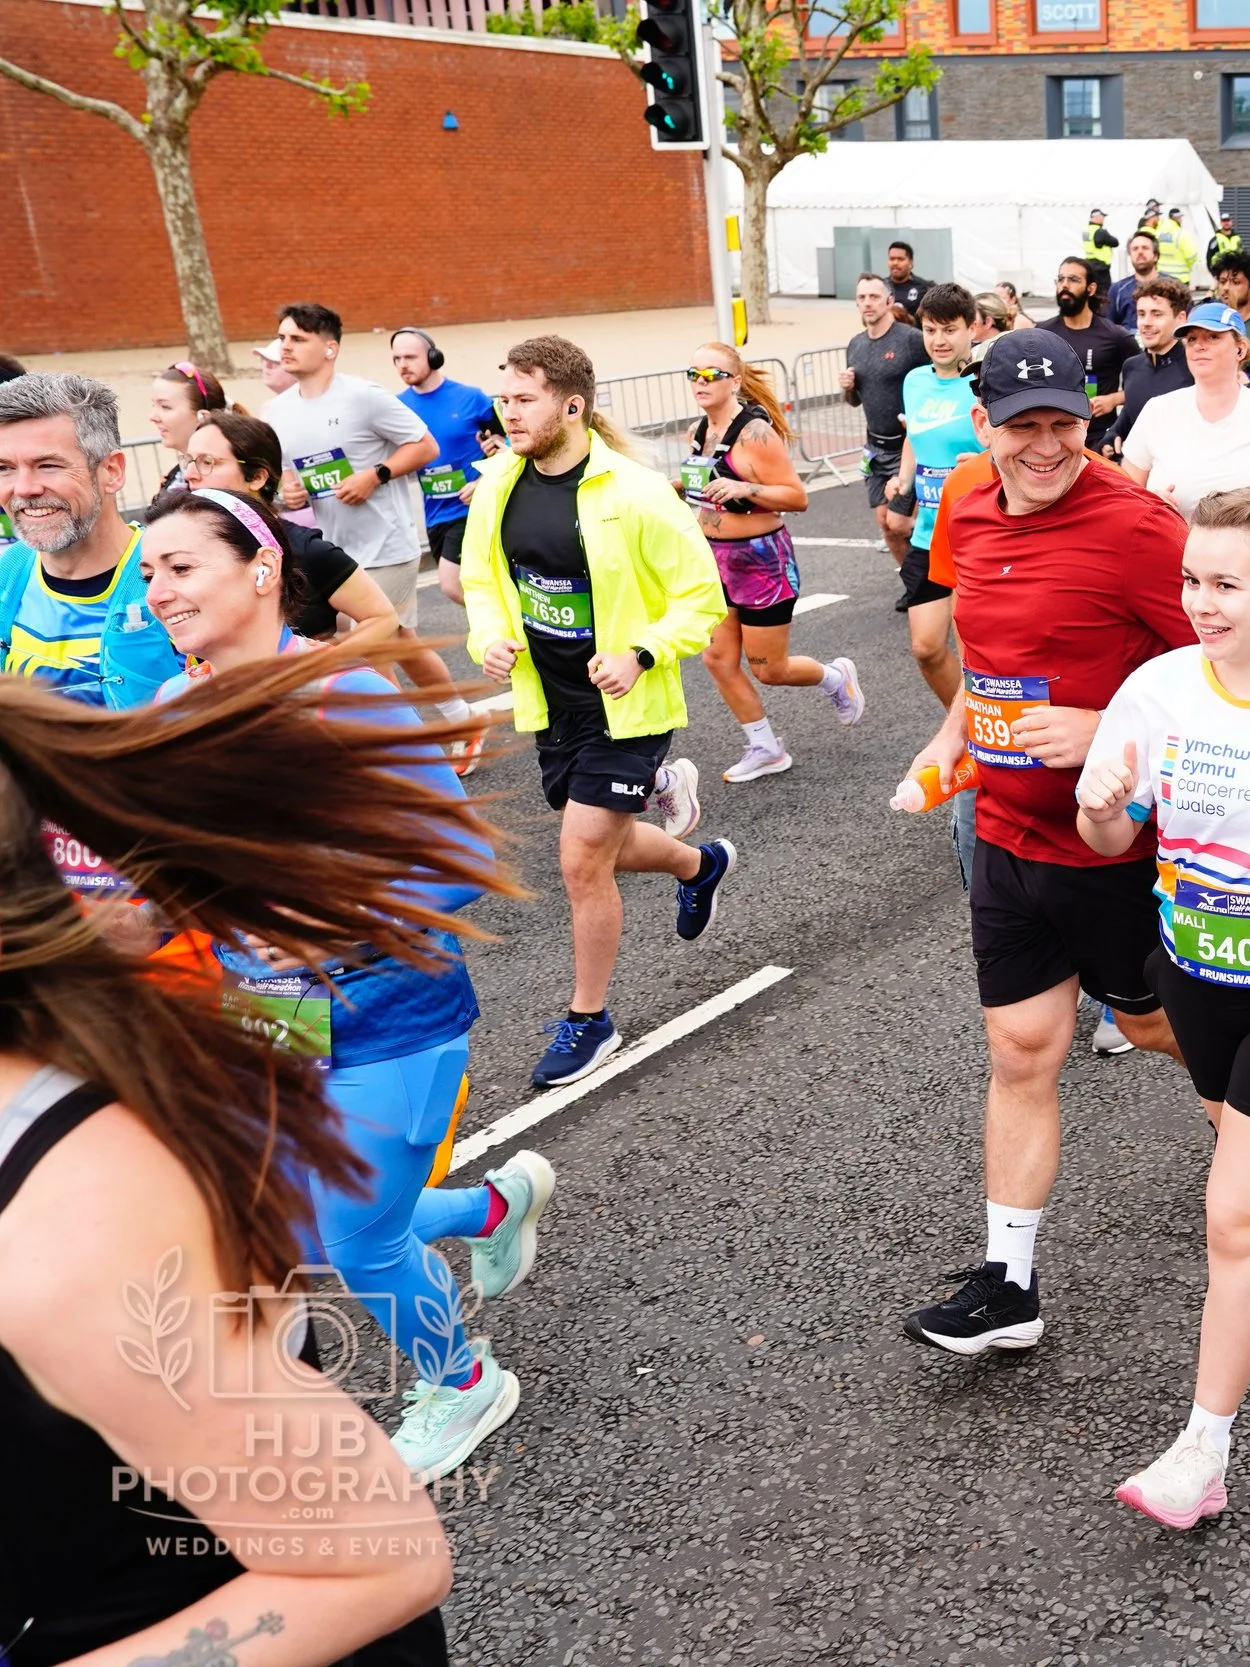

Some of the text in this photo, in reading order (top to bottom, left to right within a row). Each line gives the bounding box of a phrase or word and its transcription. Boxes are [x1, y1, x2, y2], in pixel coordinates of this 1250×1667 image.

[1042, 4, 1095, 21] SCOTT
[310, 469, 341, 490] 6767
[432, 479, 452, 492] 457
[519, 582, 551, 605] MATTHEW
[530, 597, 575, 626] 7639
[986, 678, 1022, 689] SWANSEA
[974, 715, 1024, 748] 539
[1181, 759, 1236, 779] cymru
[611, 782, 645, 797] BLK
[1177, 778, 1235, 800] cancer
[1176, 798, 1226, 817] wales
[1229, 904, 1244, 913] Half
[1173, 910, 1206, 930] MALI
[269, 983, 302, 992] Marathon
